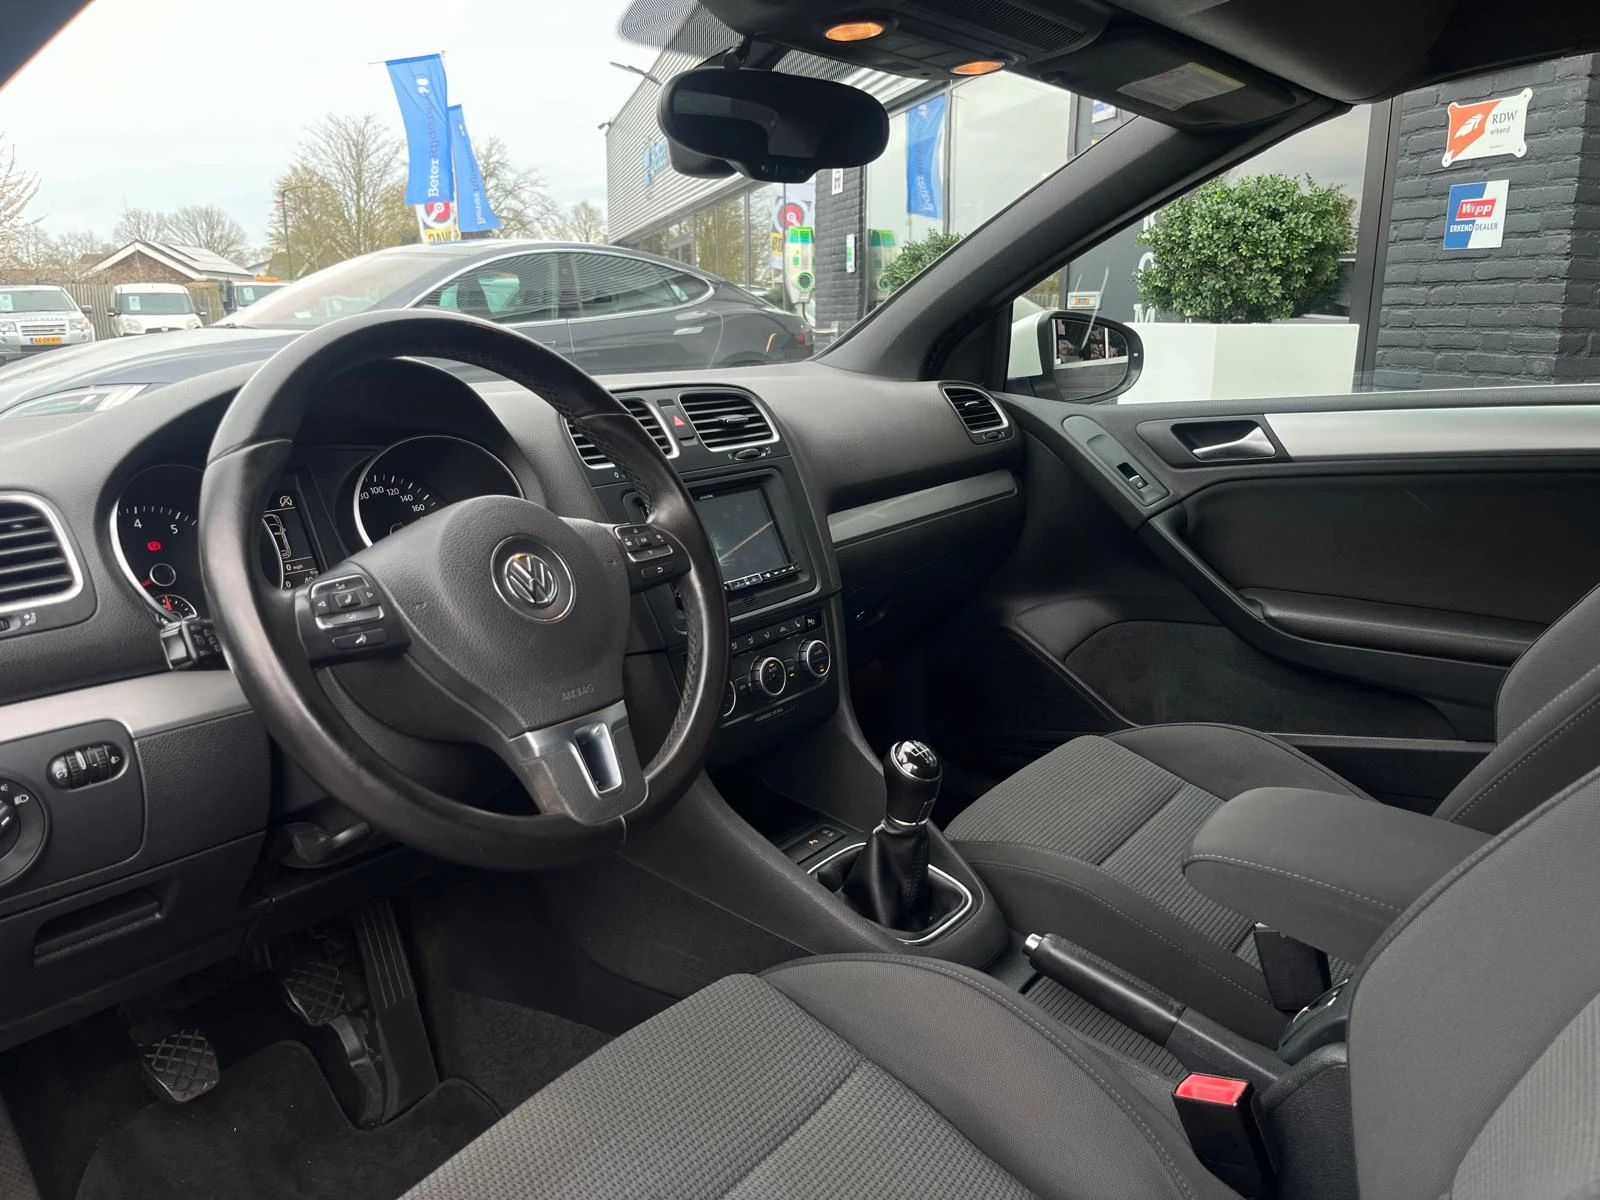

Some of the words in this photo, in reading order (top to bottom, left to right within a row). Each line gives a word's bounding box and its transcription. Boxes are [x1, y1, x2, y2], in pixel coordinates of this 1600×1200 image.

[1492, 110, 1518, 125] RDW
[1450, 224, 1474, 233] ERKEND
[1475, 222, 1498, 232] DEALER
[370, 485, 384, 495] 100
[386, 488, 400, 497] 120
[400, 494, 414, 503] 140
[411, 503, 425, 513] 160
[133, 518, 143, 529] 4
[170, 524, 179, 535] 5
